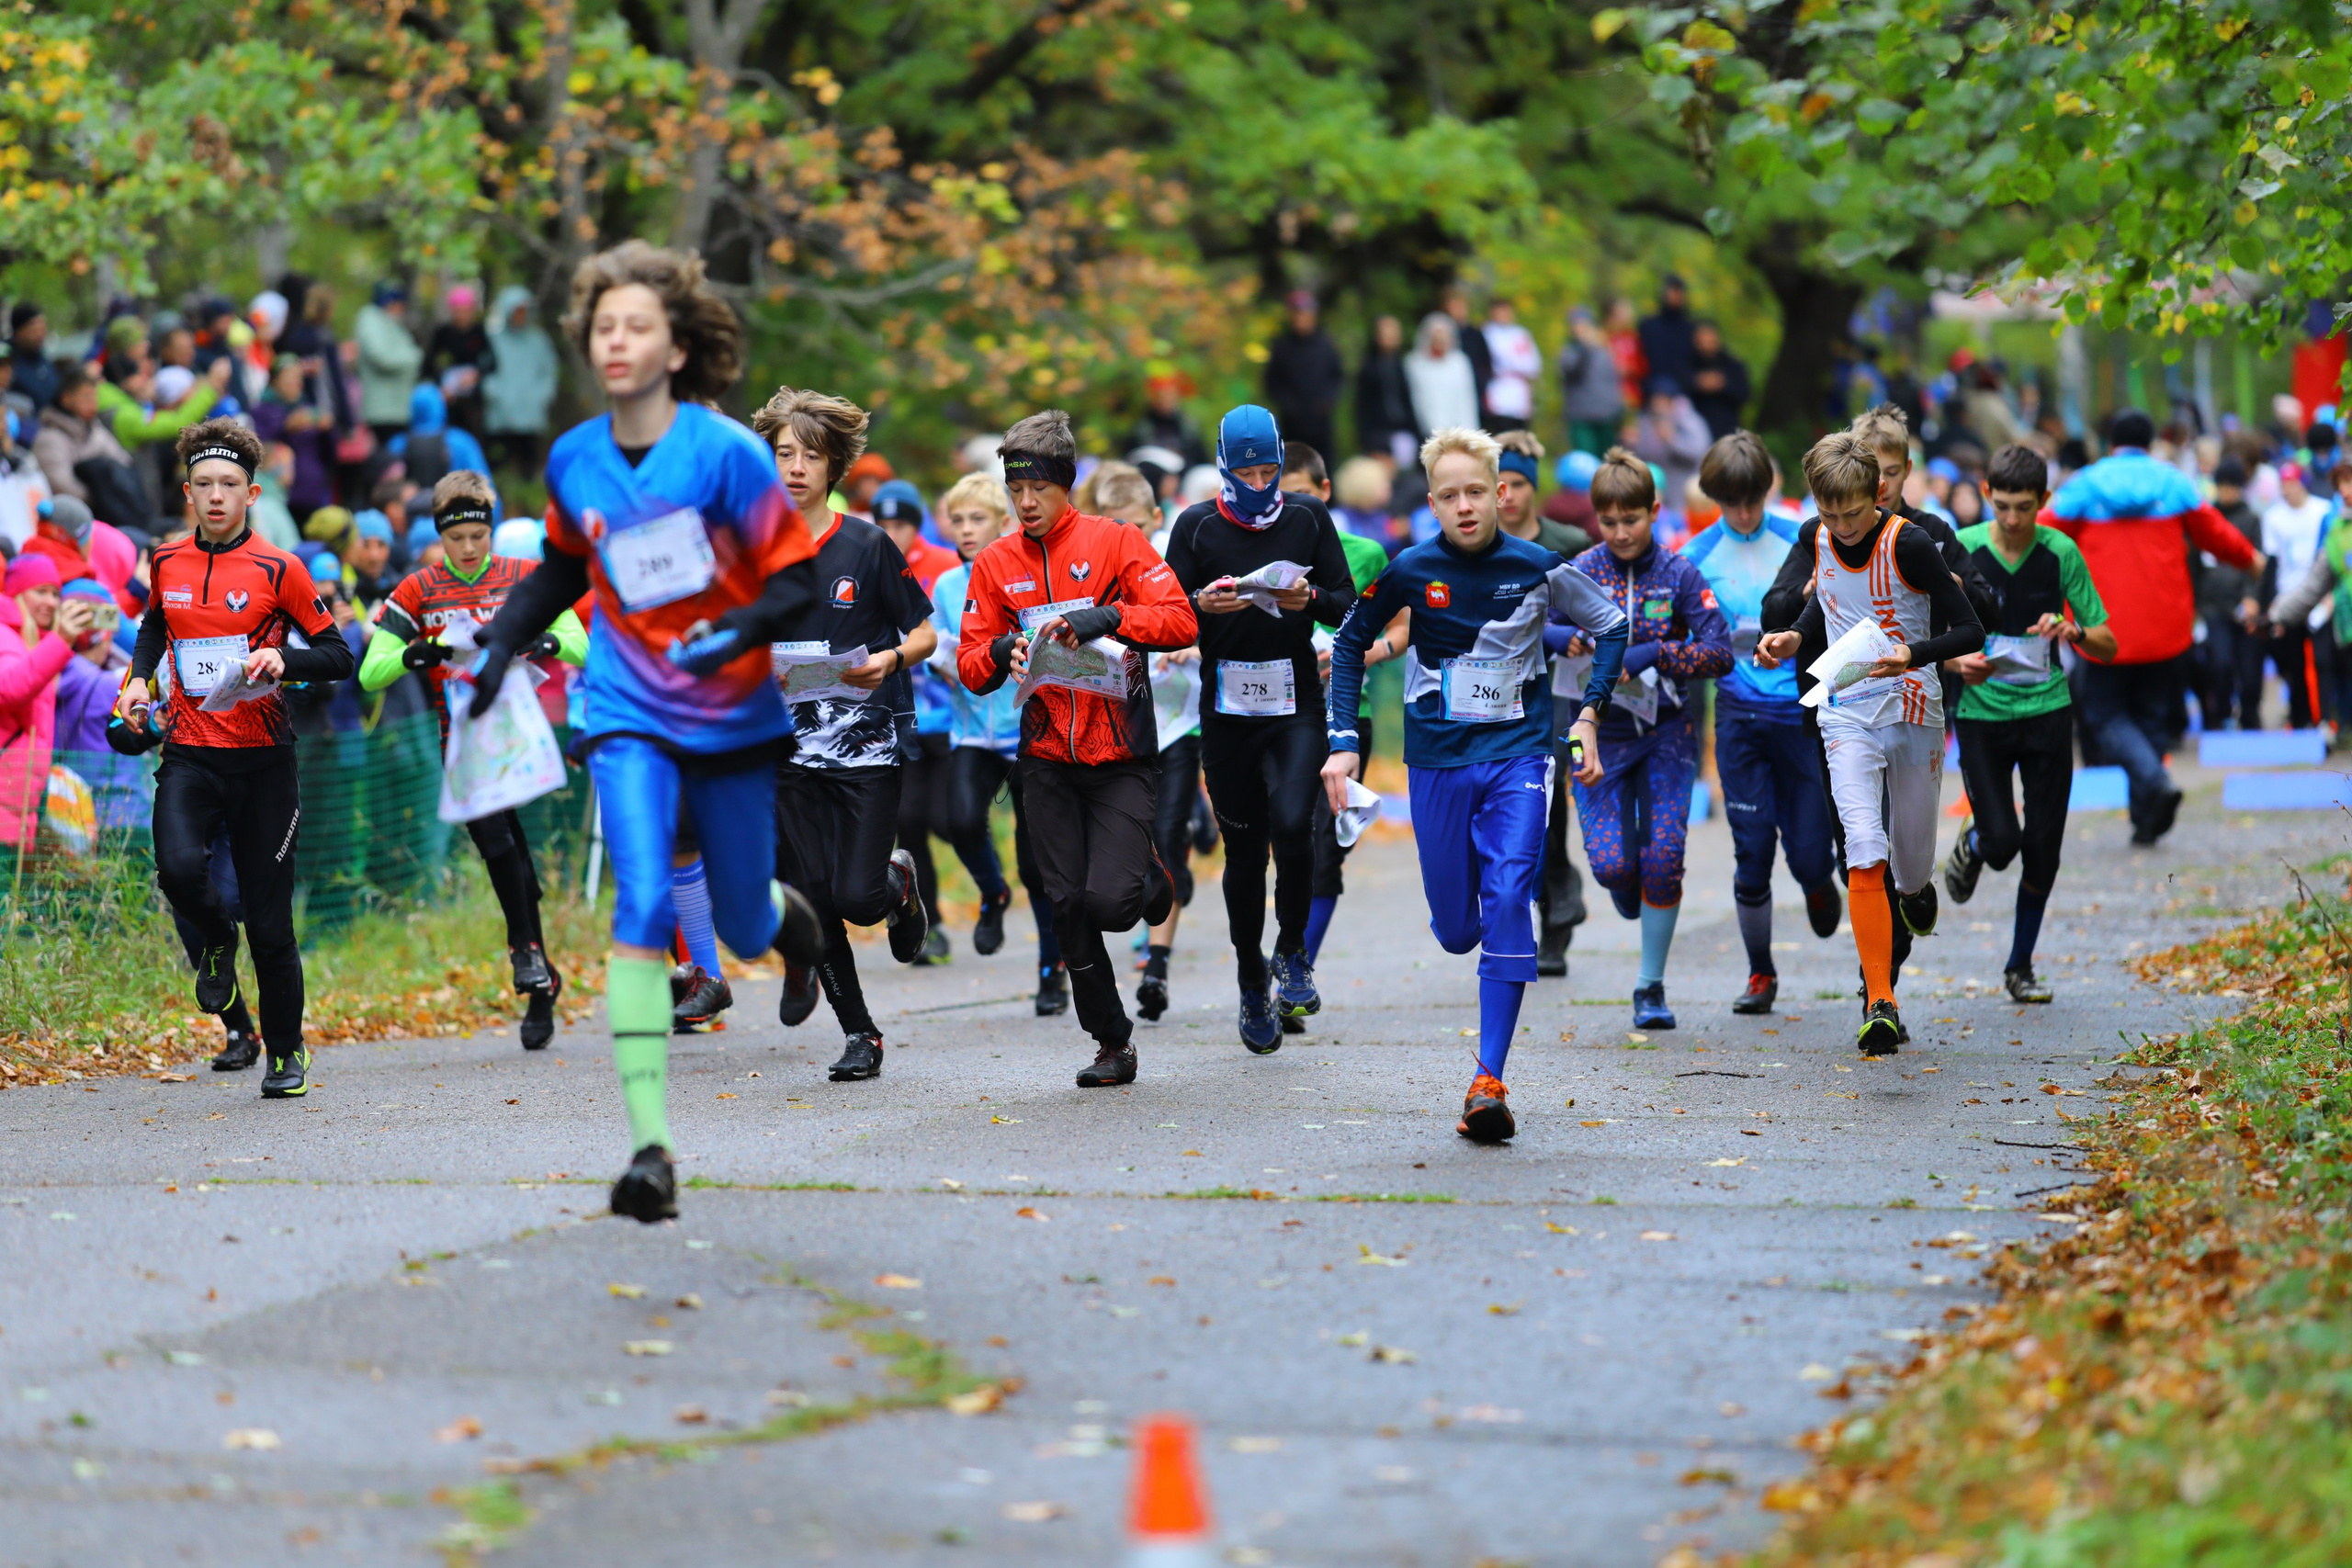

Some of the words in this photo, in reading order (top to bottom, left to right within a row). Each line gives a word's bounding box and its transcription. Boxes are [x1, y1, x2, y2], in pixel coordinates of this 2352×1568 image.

[190, 447, 239, 464] noname
[1151, 571, 1170, 583] team
[1241, 682, 1268, 695] 278
[1471, 684, 1500, 700] 286
[275, 808, 300, 863] noname
